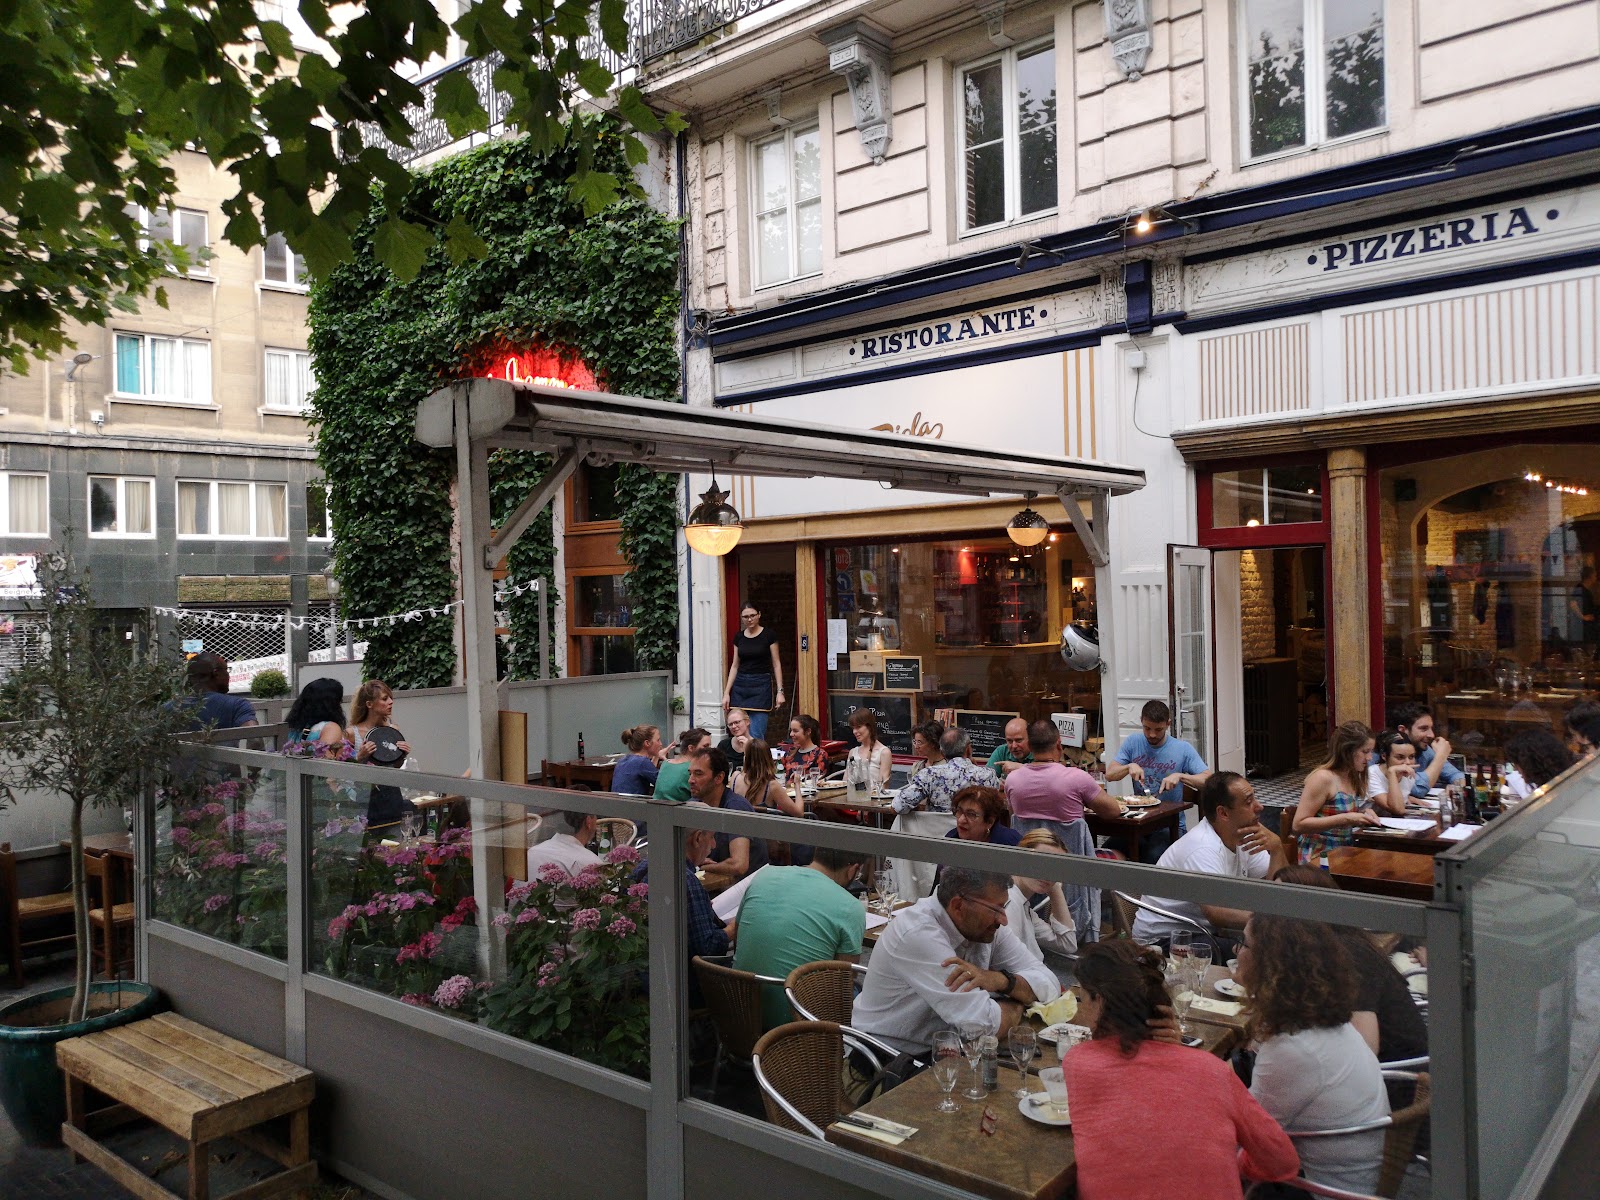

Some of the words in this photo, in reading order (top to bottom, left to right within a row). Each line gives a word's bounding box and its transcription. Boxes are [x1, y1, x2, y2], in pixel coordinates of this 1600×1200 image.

[1323, 206, 1539, 272] PIZZERIA
[861, 305, 1036, 360] RISTORANTE
[1058, 719, 1075, 732] PIZZA
